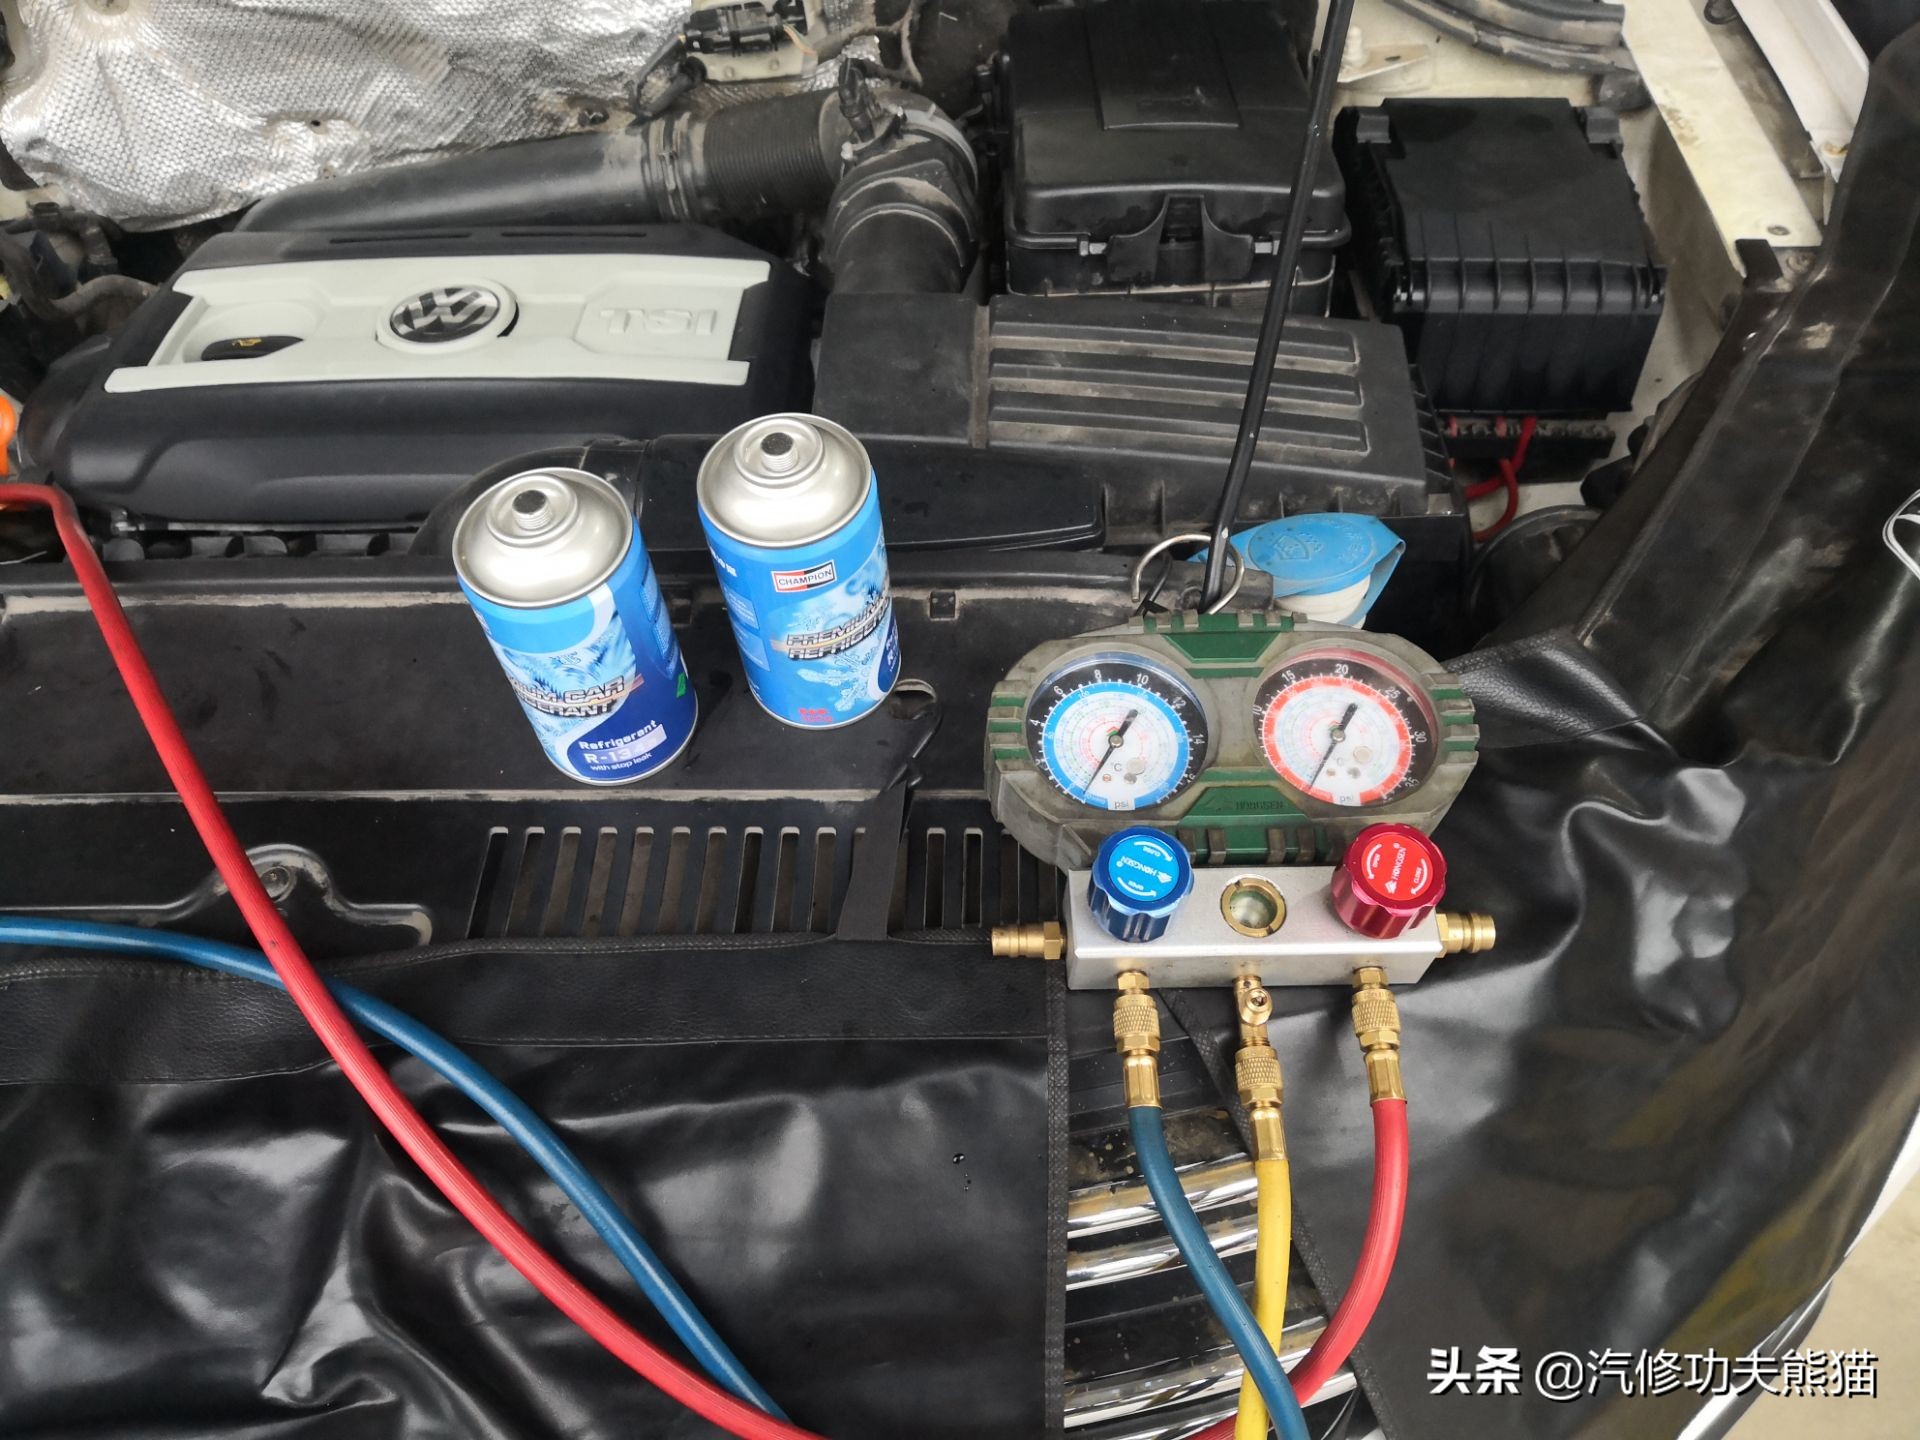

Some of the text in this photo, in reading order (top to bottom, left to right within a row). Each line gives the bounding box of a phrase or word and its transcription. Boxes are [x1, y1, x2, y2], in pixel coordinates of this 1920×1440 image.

[599, 308, 718, 336] TSI
[778, 569, 832, 586] CHAMPION
[1281, 669, 1296, 683] 15
[1335, 663, 1349, 675] 20
[1136, 673, 1149, 685] 10
[563, 675, 625, 704] CAR
[1053, 685, 1064, 695] 6
[1385, 687, 1401, 700] 25
[1172, 696, 1187, 709] 12
[578, 719, 658, 750] Refrigerant
[1414, 730, 1427, 743] 30
[590, 752, 653, 772] with stop leak
[1114, 800, 1129, 809] psi
[1120, 856, 1158, 876] HONGSEN
[1391, 846, 1407, 880] HONGSEN
